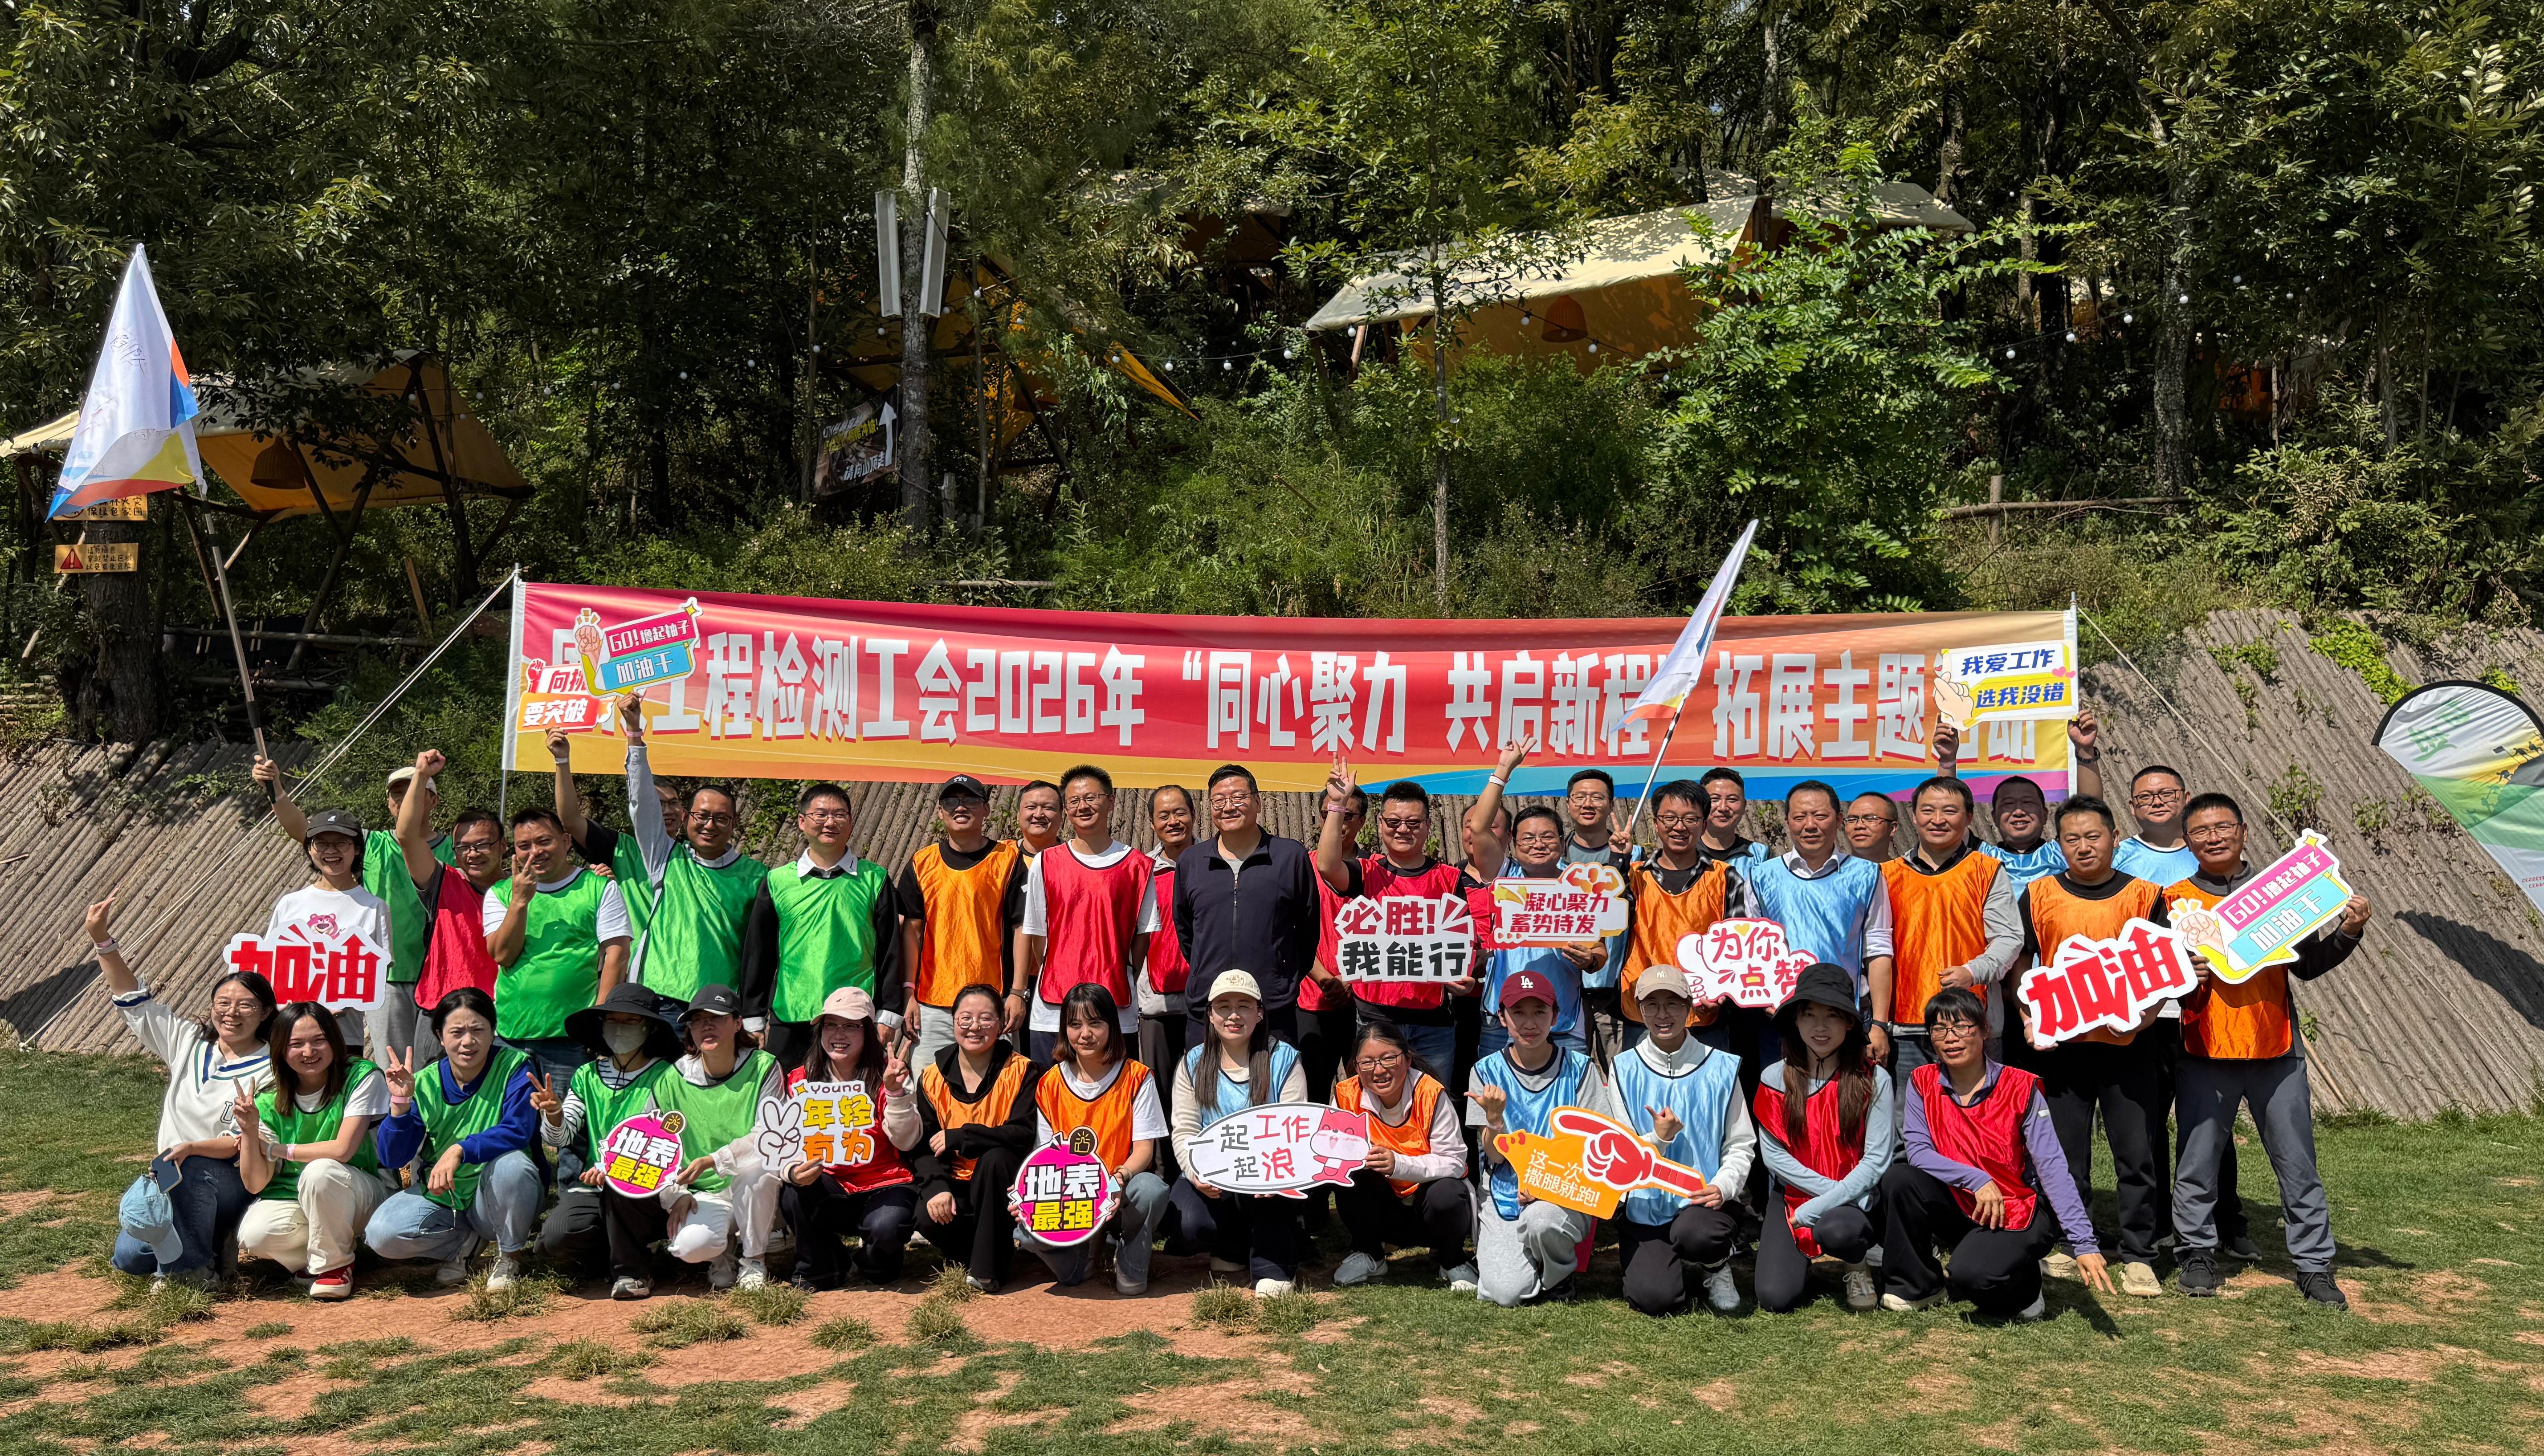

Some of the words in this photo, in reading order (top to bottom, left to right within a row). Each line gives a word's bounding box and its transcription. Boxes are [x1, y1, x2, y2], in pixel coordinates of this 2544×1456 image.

[87, 555, 132, 563] 穿越禁止区域
[616, 651, 673, 684] 加油干
[1961, 648, 2055, 676] 我爱工作
[1975, 682, 2065, 708] 选我没错
[522, 697, 589, 728] 要突破
[1342, 901, 1436, 935] 必胜!
[1523, 892, 1609, 913] 凝心聚力
[1510, 914, 1596, 934] 蓄势待发
[2249, 888, 2323, 952] 加油干
[1342, 940, 1467, 976] 我能行
[1711, 927, 1780, 963] 为你
[231, 933, 381, 1005] 加油
[1520, 976, 1533, 989] LA
[2026, 926, 2186, 1037] 加油
[811, 1083, 862, 1095] Young
[803, 1094, 872, 1130] 年轻
[610, 1126, 681, 1168] 地表
[803, 1129, 872, 1163] 有为
[1188, 1114, 1311, 1152] 一起工作
[607, 1158, 664, 1190] 最强
[1023, 1163, 1101, 1200] 地表
[1203, 1147, 1296, 1182] 一起浪
[1528, 1148, 1584, 1183] 这一次
[1522, 1166, 1601, 1208] 撒腿就跑!
[1031, 1200, 1093, 1232] 最强
